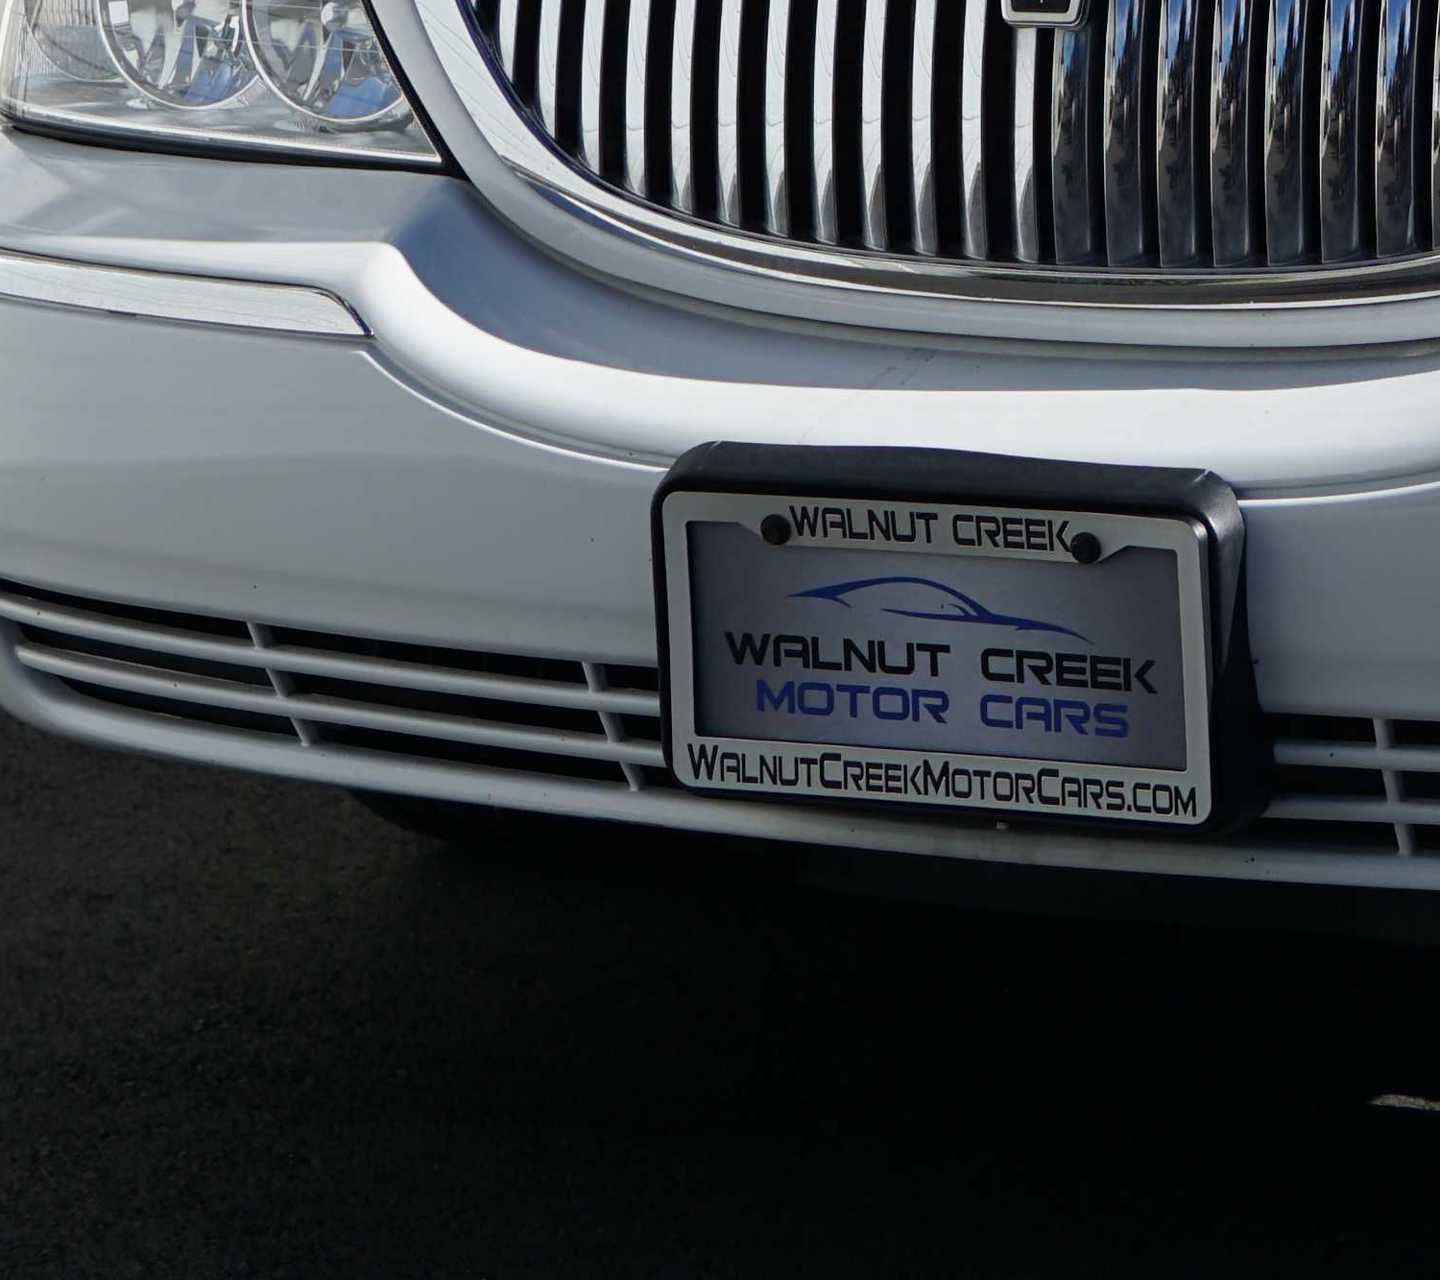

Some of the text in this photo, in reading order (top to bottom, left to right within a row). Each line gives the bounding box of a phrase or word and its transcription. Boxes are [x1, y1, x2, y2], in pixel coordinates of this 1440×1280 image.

[789, 504, 1075, 554] WALNUT CREEK
[724, 631, 1158, 695] WALNUT CREEK
[756, 679, 1129, 739] MOTOR CARS
